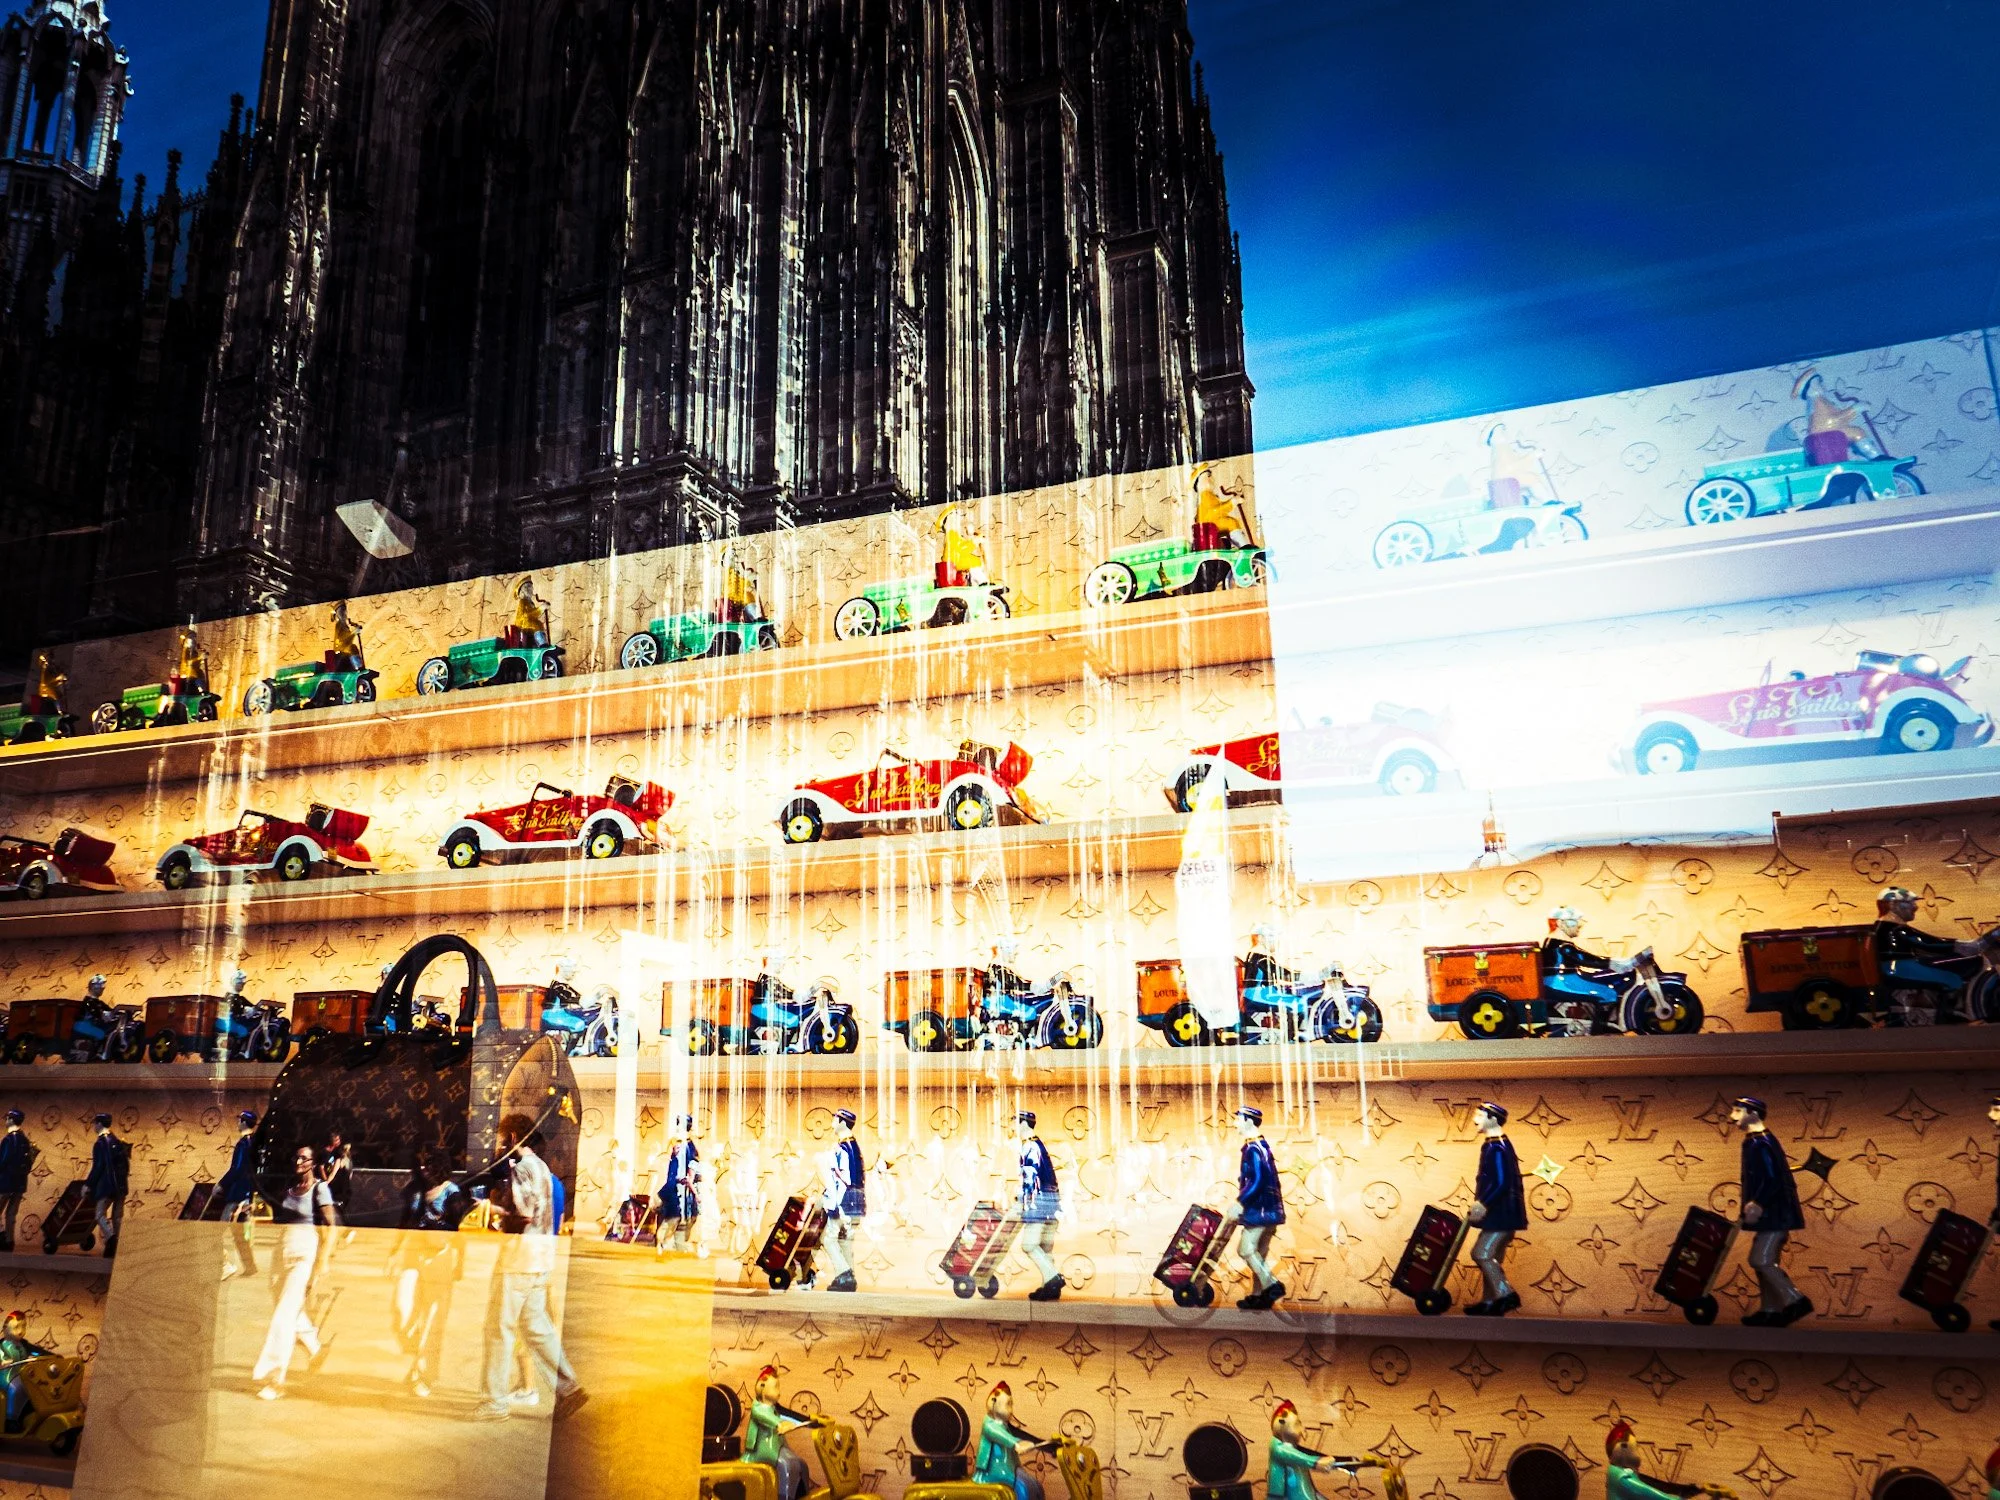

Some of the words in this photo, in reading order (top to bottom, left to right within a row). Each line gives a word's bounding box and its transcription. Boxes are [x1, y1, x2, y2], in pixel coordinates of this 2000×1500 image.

[1445, 976, 1476, 987] LOUIS
[1479, 974, 1524, 985] VUITTON
[1153, 988, 1179, 998] LOUIS
